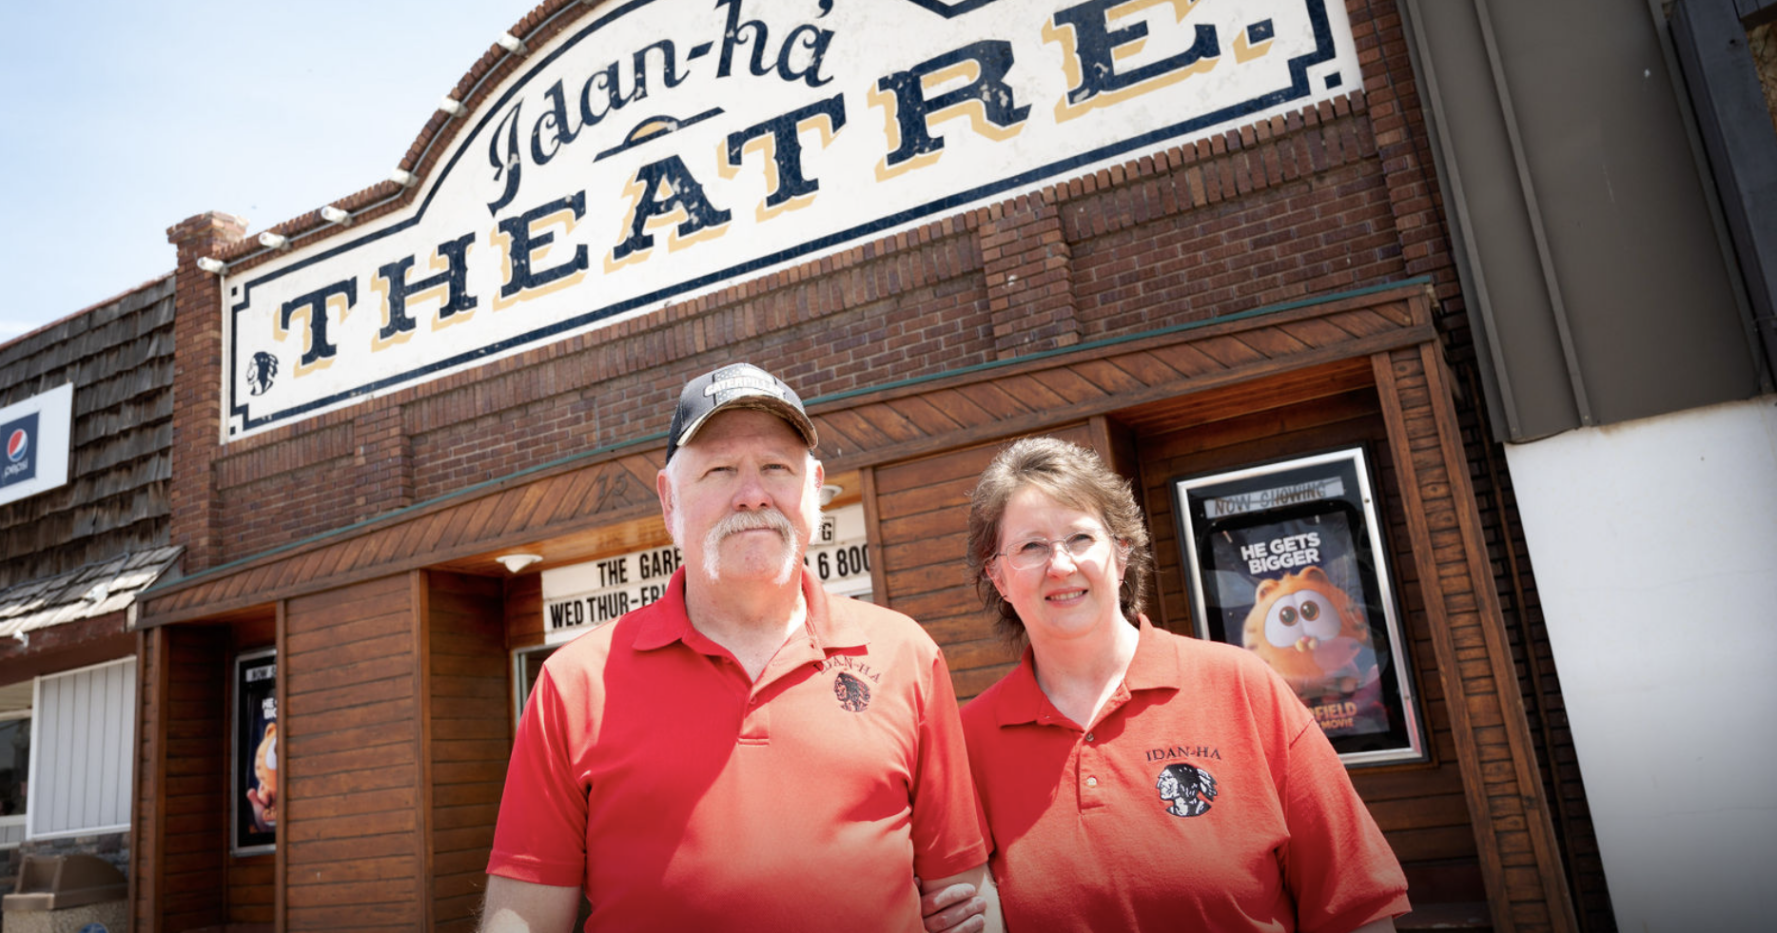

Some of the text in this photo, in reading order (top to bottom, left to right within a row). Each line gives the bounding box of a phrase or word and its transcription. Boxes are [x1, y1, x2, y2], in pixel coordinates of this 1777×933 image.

[1214, 481, 1326, 516] NOW SHOWING
[1240, 531, 1321, 561] HE GETS
[1248, 547, 1321, 575] BIGGER
[597, 558, 628, 588] THE
[817, 551, 830, 581] 6
[550, 600, 584, 629] WED
[812, 654, 881, 684] IDAN-HA
[1145, 746, 1222, 762] IDAN-HA
